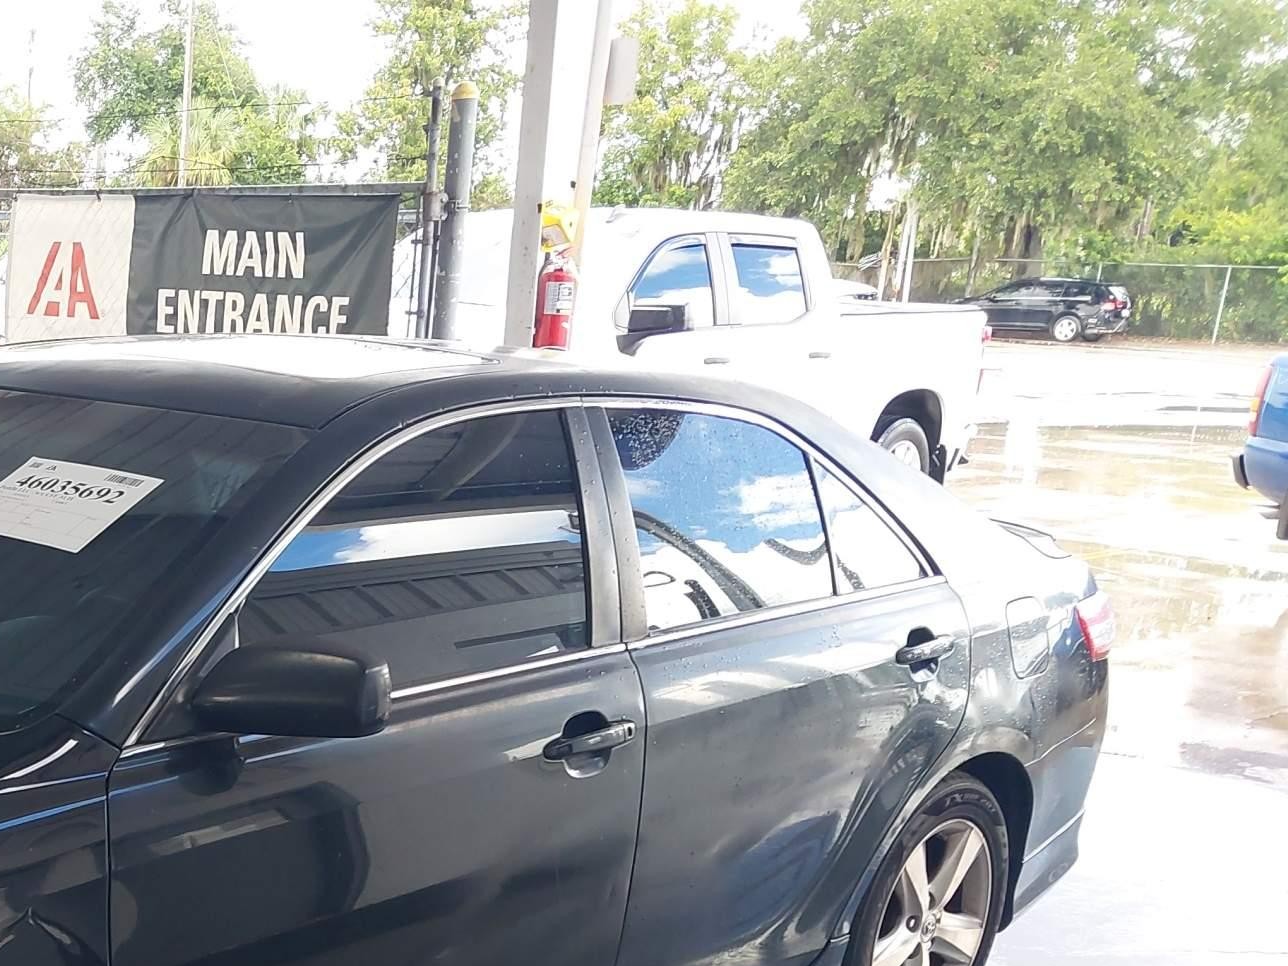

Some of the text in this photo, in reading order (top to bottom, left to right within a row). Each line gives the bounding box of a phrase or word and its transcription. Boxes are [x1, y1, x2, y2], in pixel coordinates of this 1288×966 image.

[201, 229, 306, 279] MAIN
[156, 289, 350, 335] ENTRANCE
[15, 474, 125, 504] 46035692
